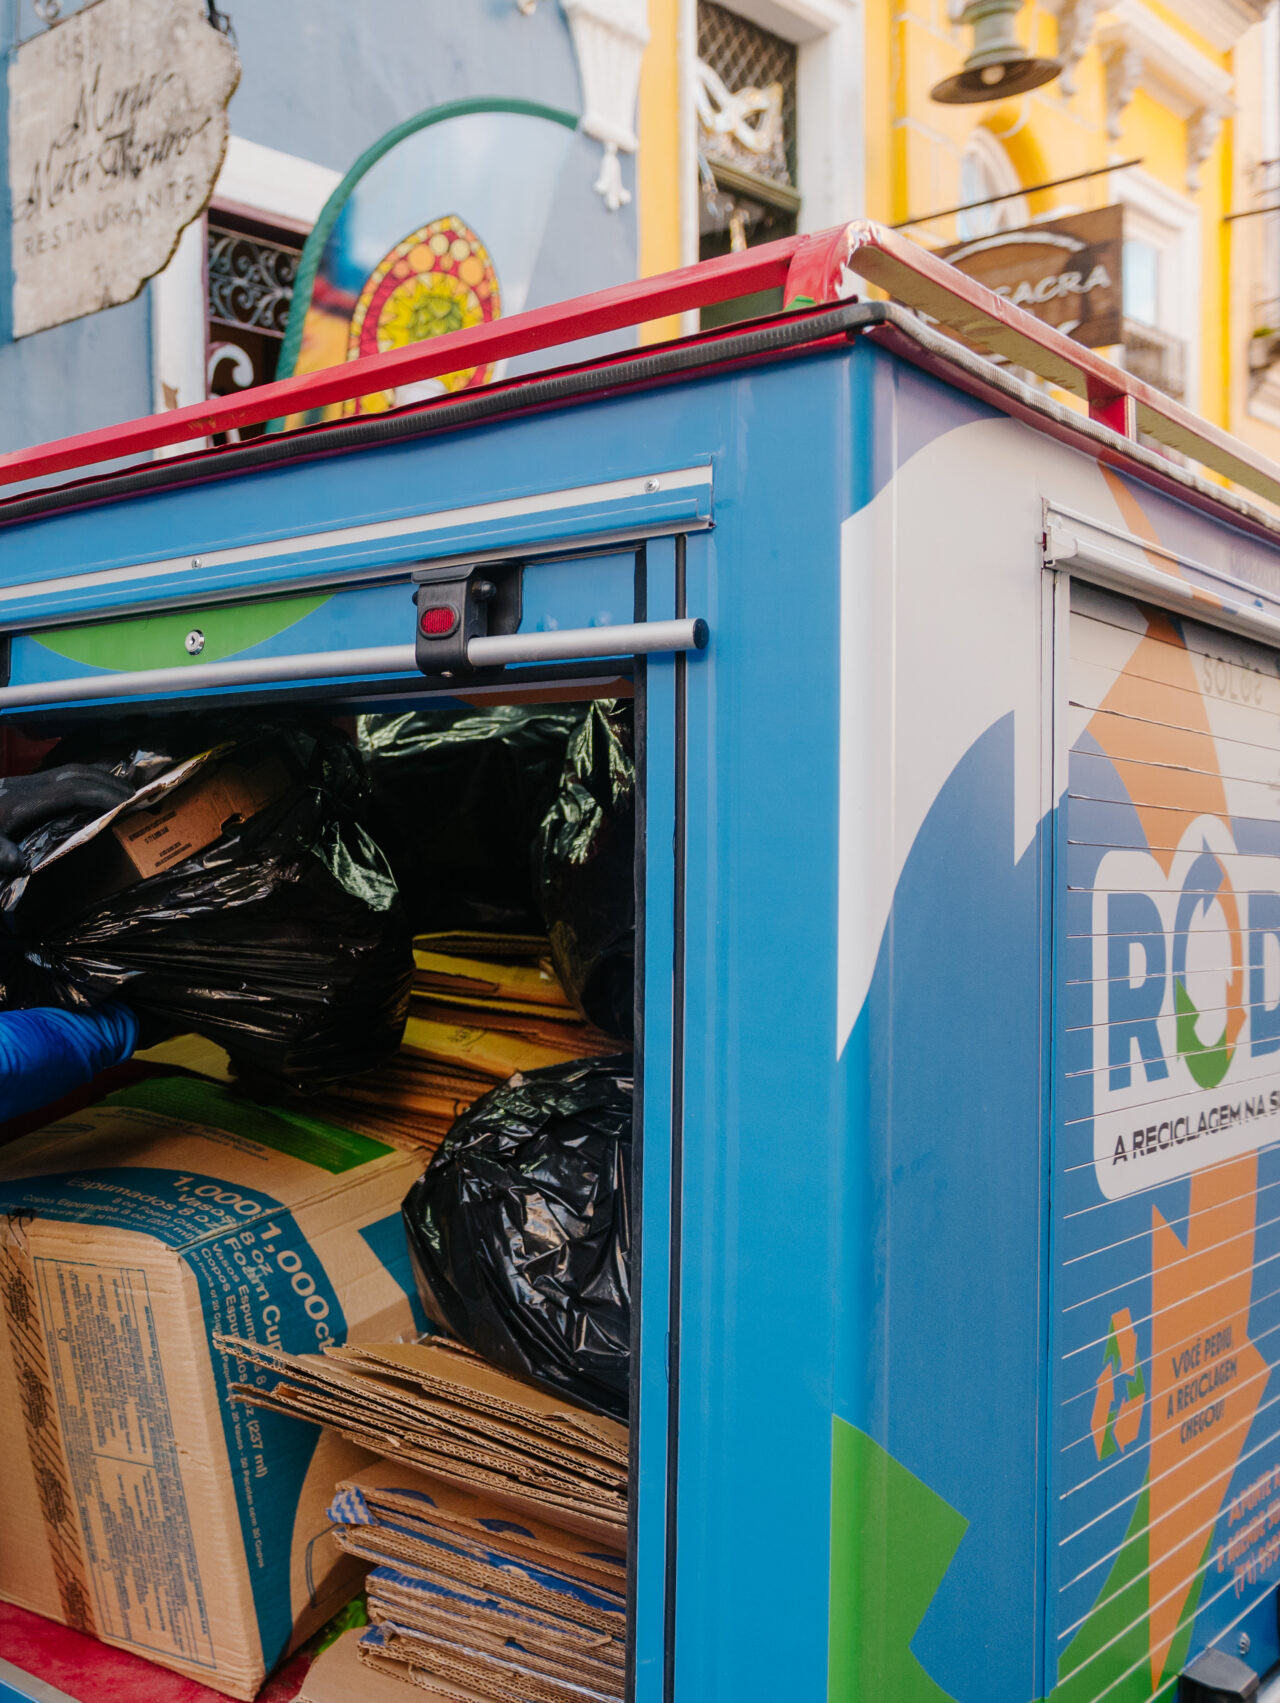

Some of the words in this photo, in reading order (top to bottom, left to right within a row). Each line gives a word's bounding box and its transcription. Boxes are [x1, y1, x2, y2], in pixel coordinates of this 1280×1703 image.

[24, 175, 195, 257] RESTAURANTE
[1112, 1135, 1128, 1166] A
[1132, 1101, 1242, 1160] RECICLAGEM
[1245, 1094, 1267, 1124] NA
[66, 1176, 177, 1212] Espumados
[177, 1207, 196, 1216] 8
[193, 1214, 221, 1230] oz
[201, 1247, 231, 1292] Copos
[223, 1236, 270, 1302] Foam
[239, 1231, 256, 1246] 8
[251, 1249, 274, 1276] oz
[212, 1243, 241, 1283] Vasos
[255, 1375, 267, 1386] 8
[1172, 1336, 1202, 1378] VOCÊ
[1166, 1394, 1174, 1420] A
[1177, 1357, 1237, 1413] RECICLAGEM
[245, 1419, 264, 1451] (237
[253, 1454, 269, 1479] ml)
